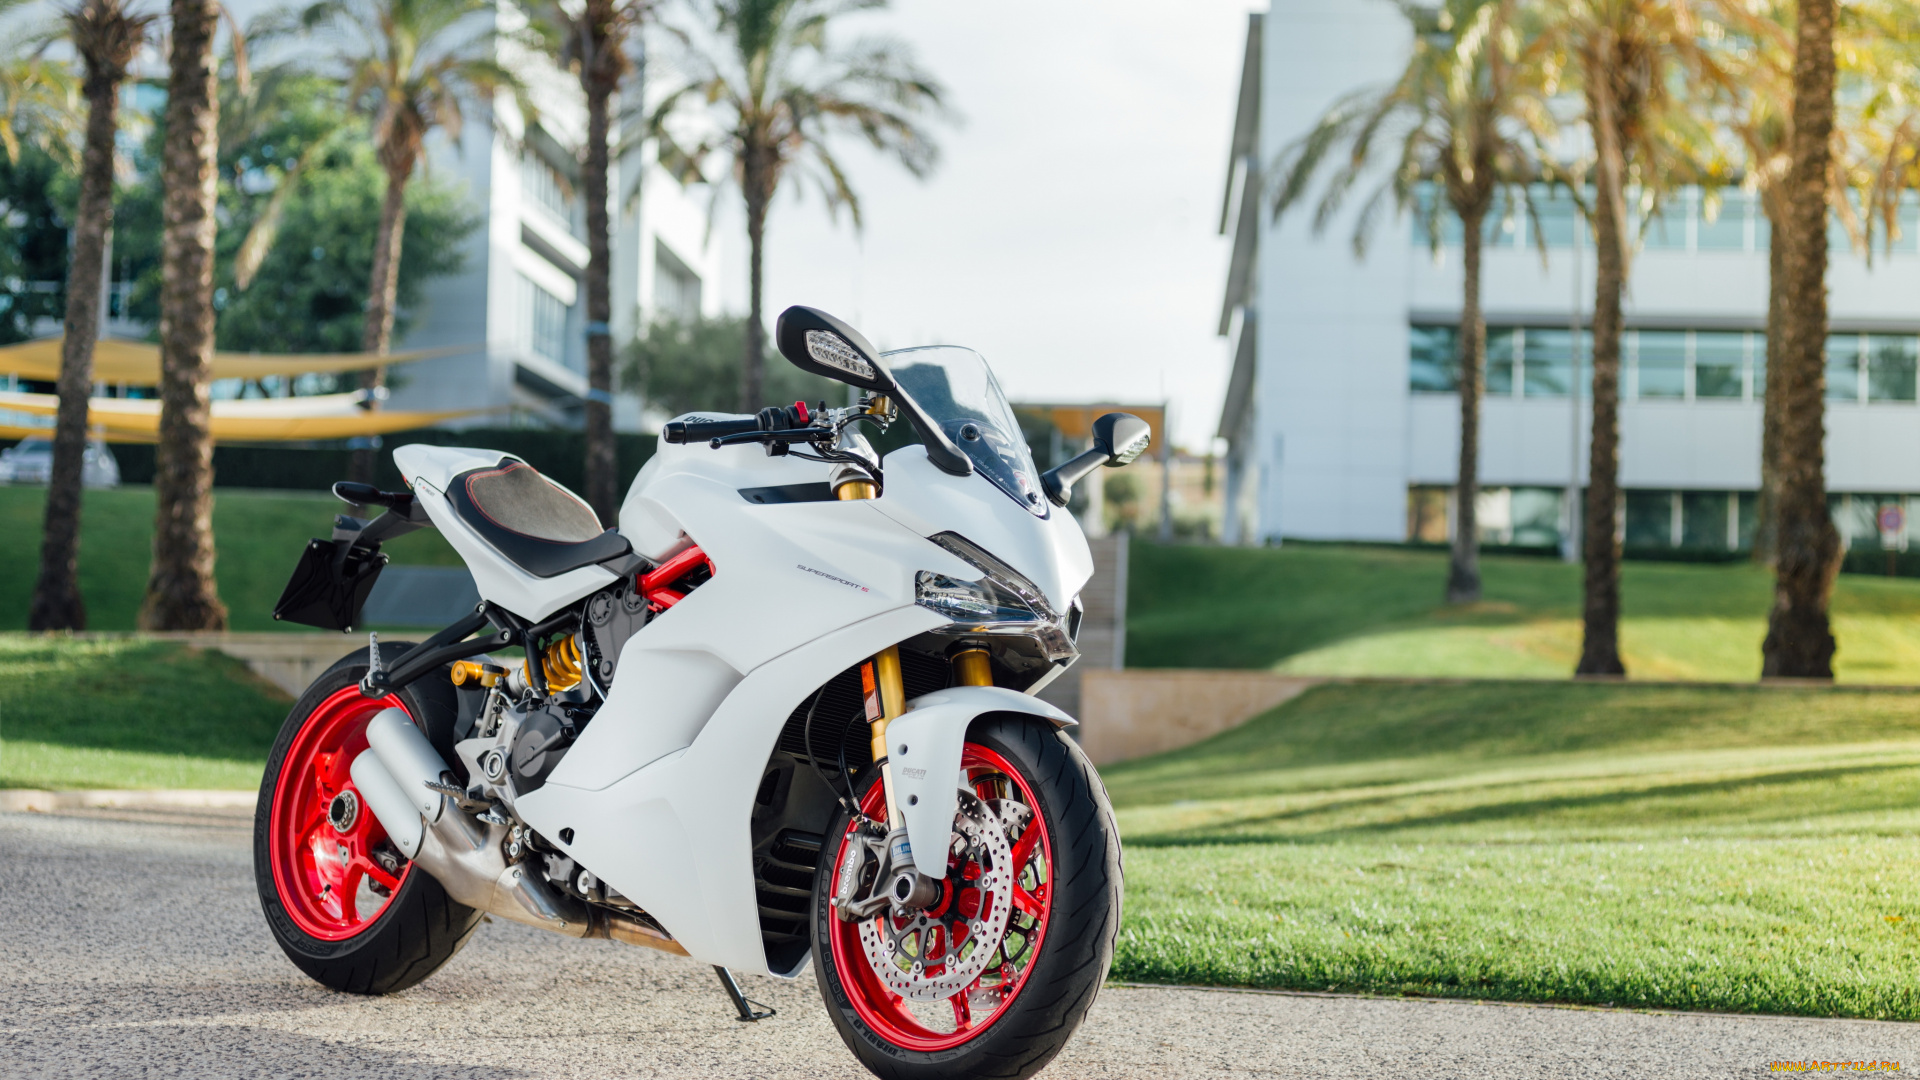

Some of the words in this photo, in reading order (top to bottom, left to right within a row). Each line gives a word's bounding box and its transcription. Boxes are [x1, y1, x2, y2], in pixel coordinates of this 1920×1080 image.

[797, 564, 861, 588] SUPERSPORT
[903, 767, 927, 775] DUCATI
[840, 850, 856, 894] brembo
[823, 951, 846, 1003] ROSSO
[853, 1019, 899, 1057] DIABLO
